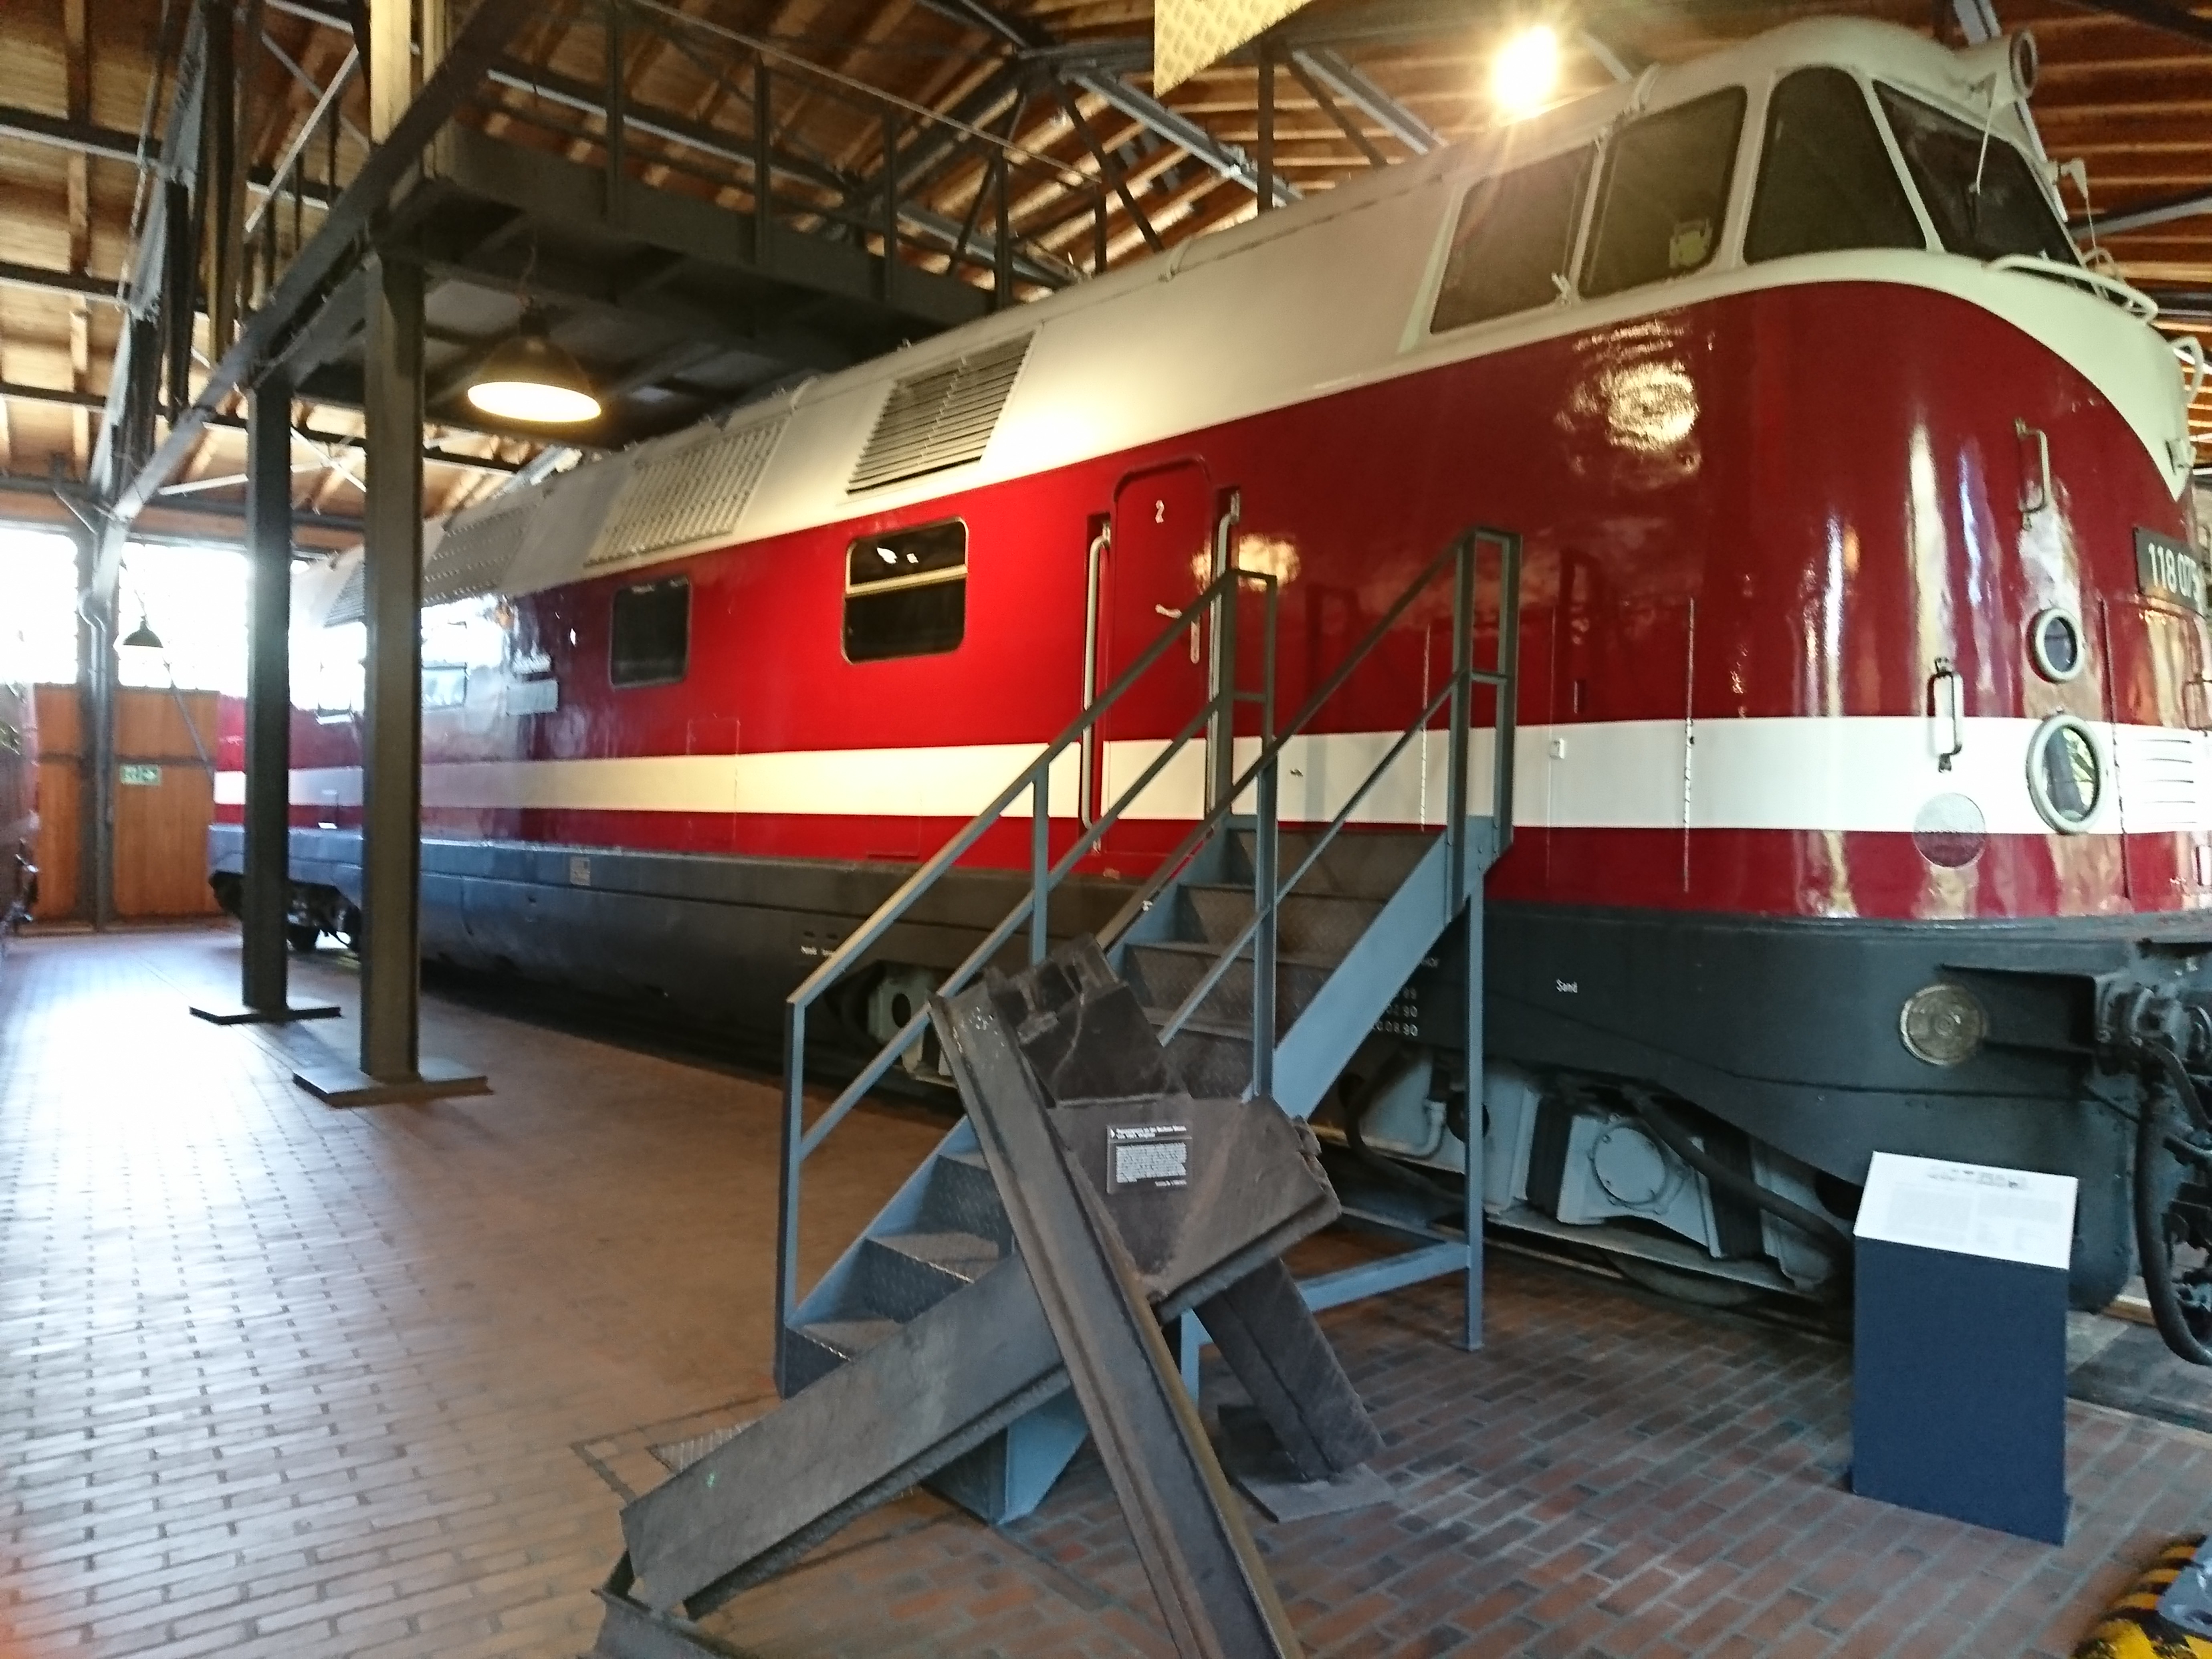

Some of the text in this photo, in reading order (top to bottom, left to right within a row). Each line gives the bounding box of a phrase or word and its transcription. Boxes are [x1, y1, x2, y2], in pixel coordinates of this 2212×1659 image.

[1155, 499, 1165, 523] 2
[2148, 542, 2178, 593] 118
[1556, 979, 1578, 993] Sand
